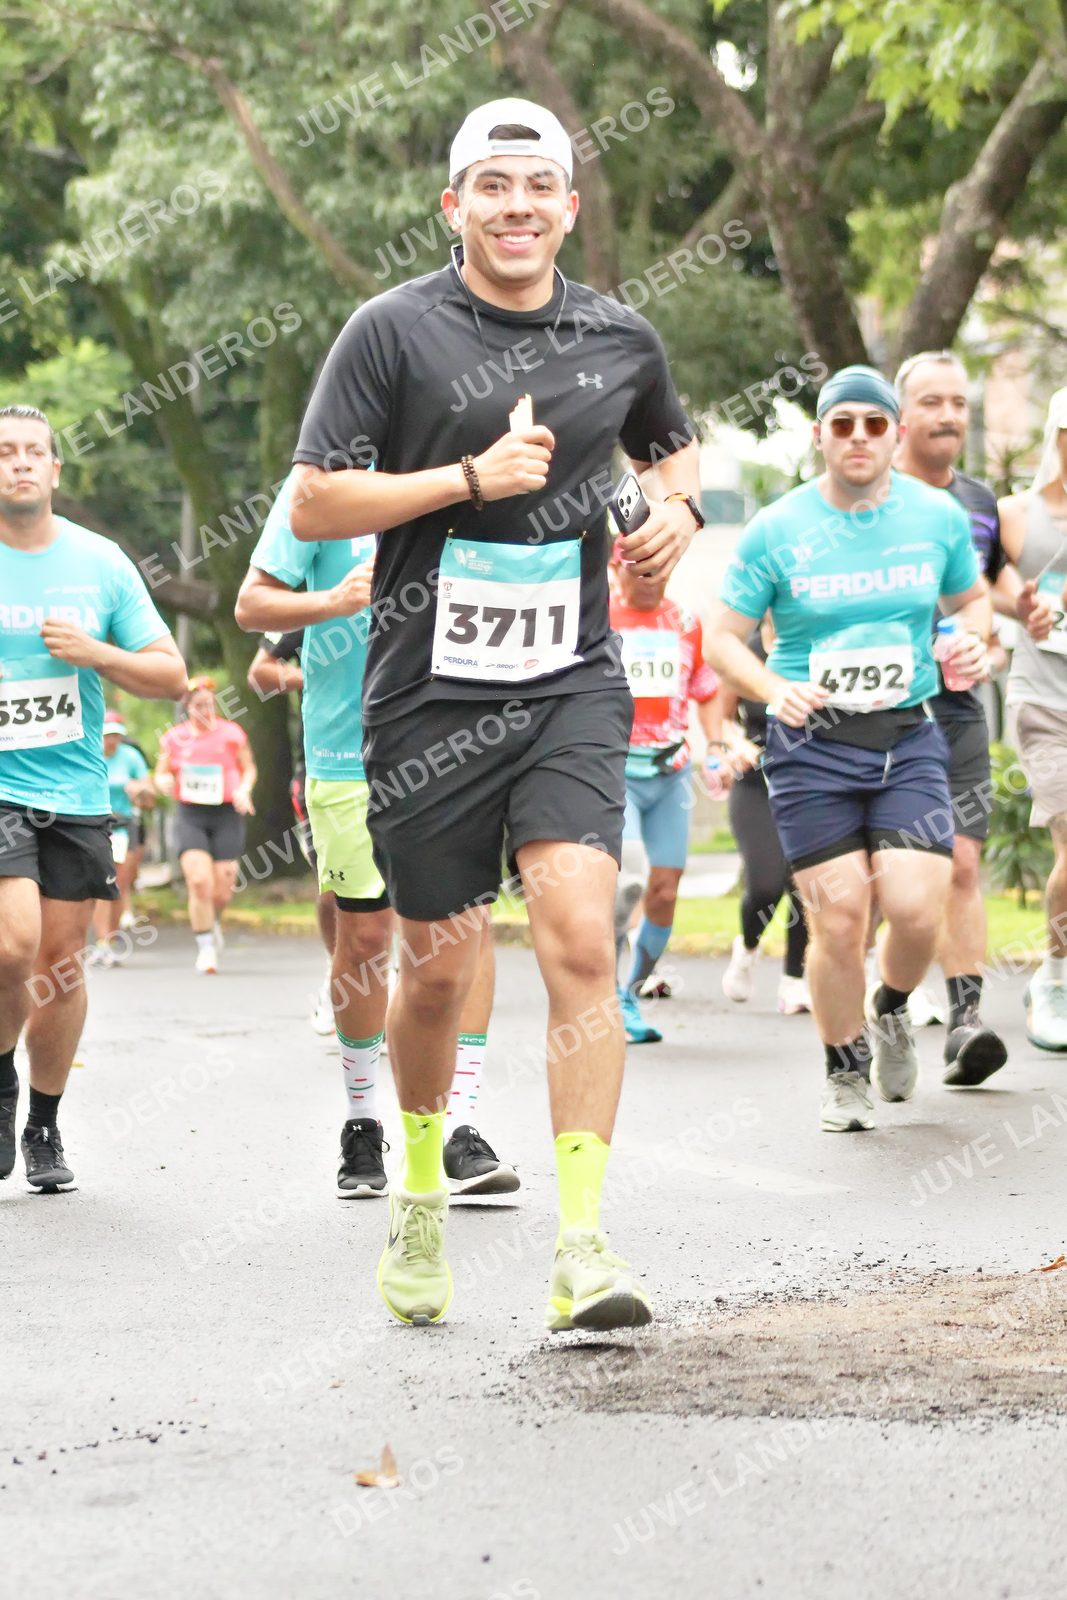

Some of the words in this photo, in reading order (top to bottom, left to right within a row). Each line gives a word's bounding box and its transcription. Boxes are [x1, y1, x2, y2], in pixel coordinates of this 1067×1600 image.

[789, 561, 937, 599] PERDURA
[445, 602, 566, 648] 3711
[443, 656, 479, 667] PERDURA
[630, 661, 674, 678] 610
[818, 663, 905, 694] 4792
